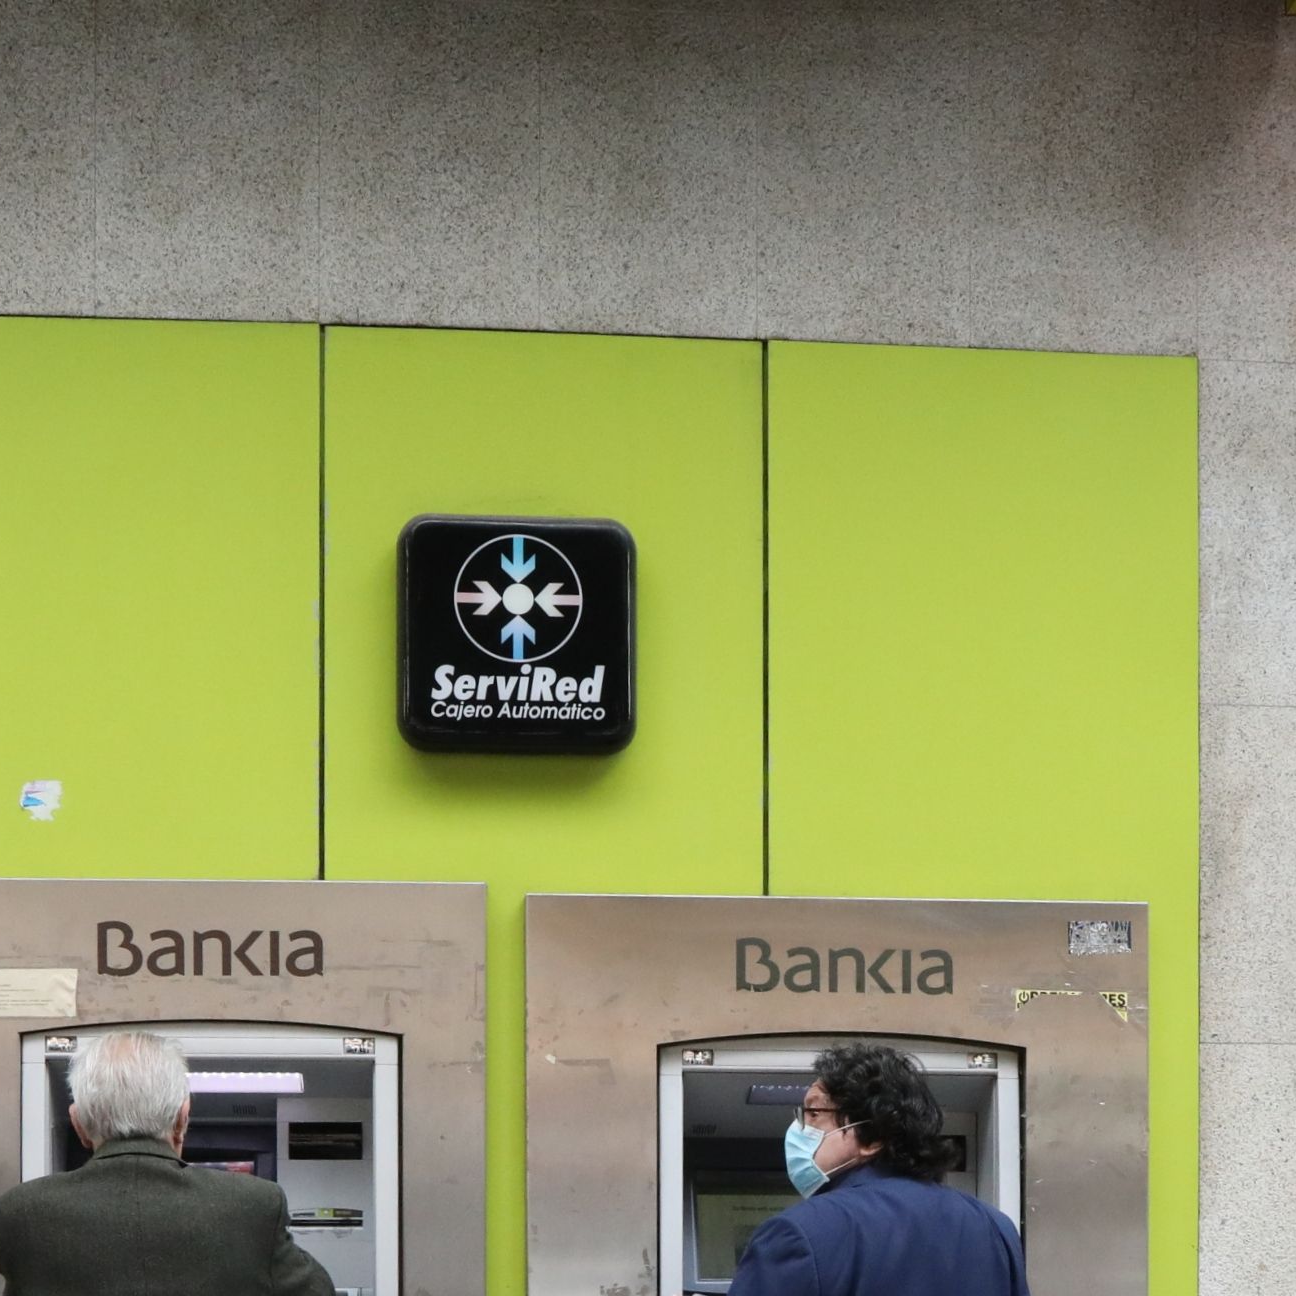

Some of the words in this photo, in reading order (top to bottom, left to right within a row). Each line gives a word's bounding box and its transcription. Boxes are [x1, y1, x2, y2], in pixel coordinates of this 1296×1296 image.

[431, 664, 606, 703] ServiRed
[431, 701, 493, 720] Cajero
[497, 702, 606, 720] Automático
[96, 921, 324, 977] Bankia
[735, 937, 954, 995] Bankia
